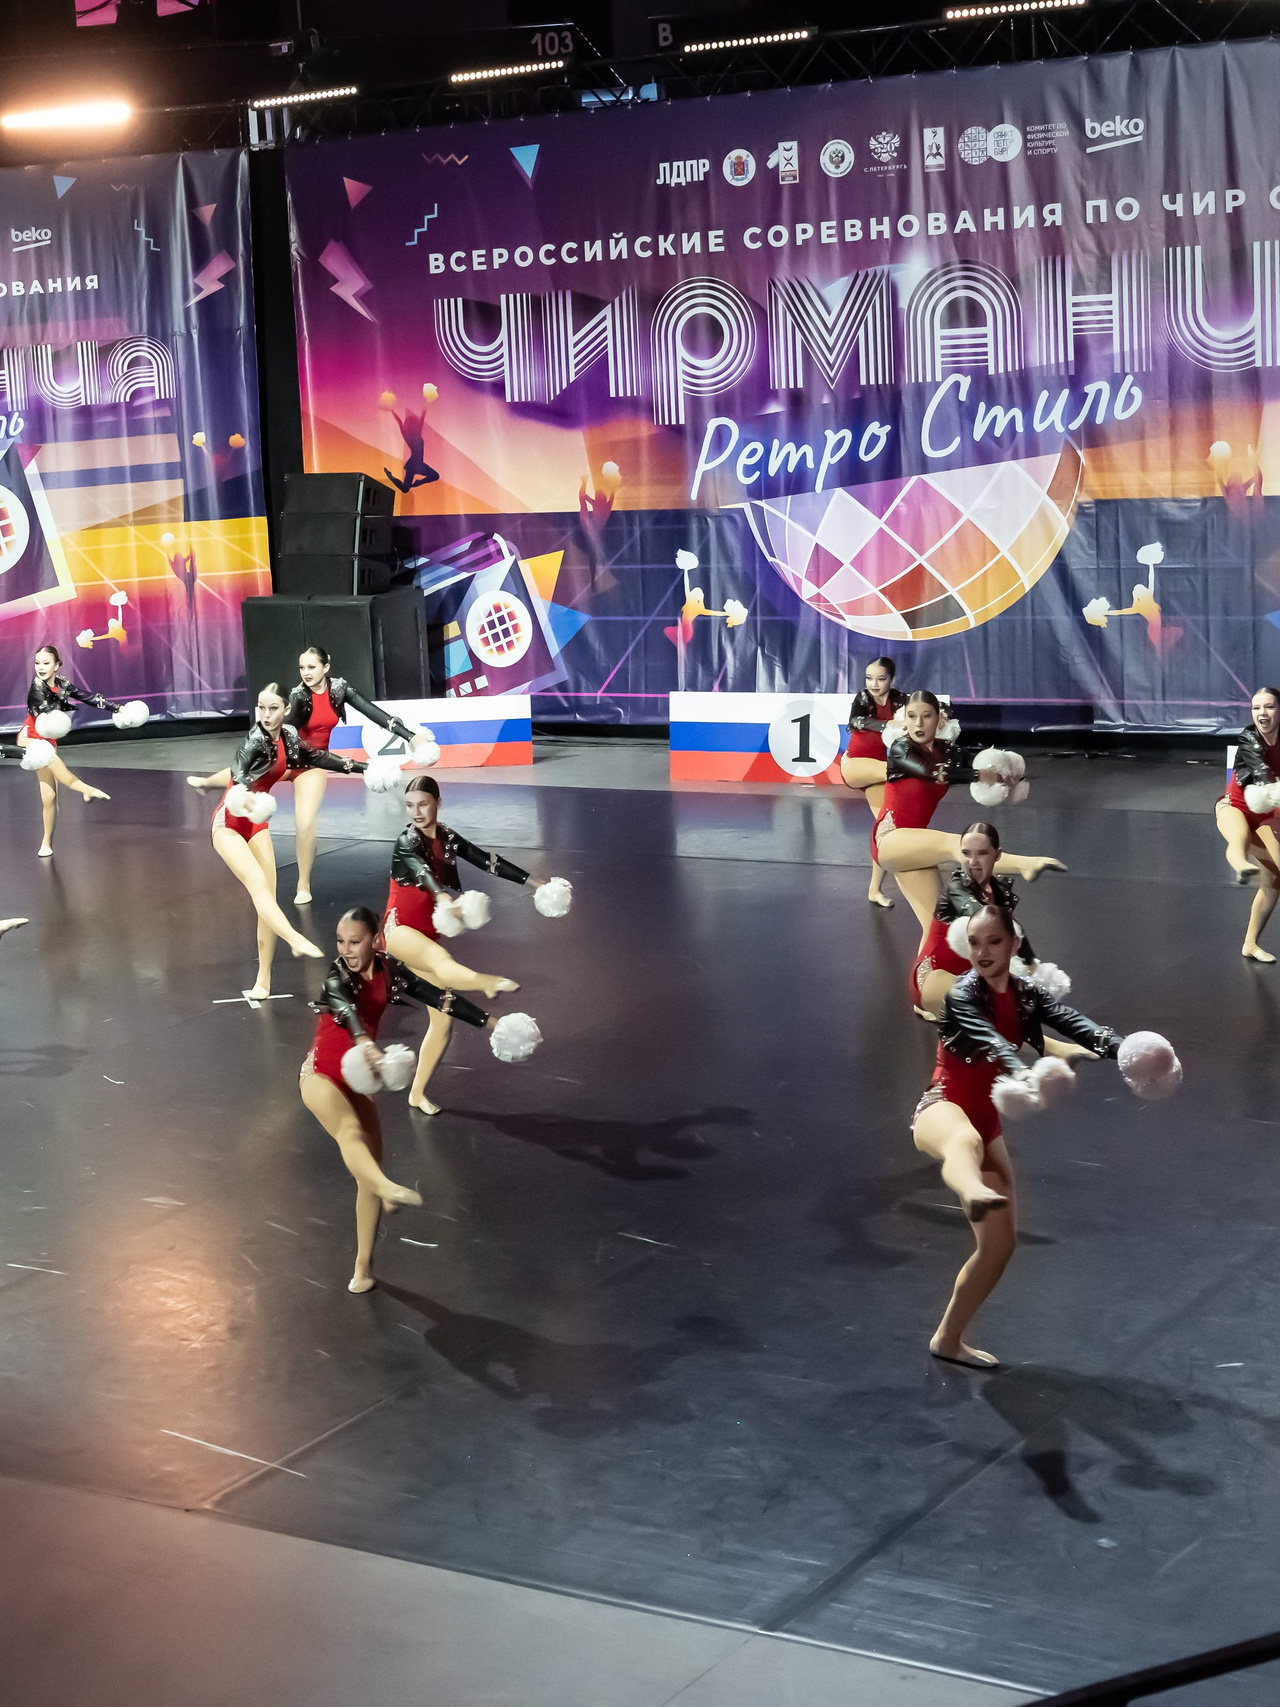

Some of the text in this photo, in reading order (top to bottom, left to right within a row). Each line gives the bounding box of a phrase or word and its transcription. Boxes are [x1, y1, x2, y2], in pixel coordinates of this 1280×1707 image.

[531, 31, 574, 57] 103
[1026, 123, 1055, 132] КОМИТЕТ
[1026, 130, 1070, 140] ФИЗИЧЕСКОЙ
[1085, 115, 1144, 139] beko
[1026, 140, 1056, 148] КУЛЬТУРЕ
[656, 159, 710, 187] ЛДПР
[11, 226, 52, 243] beko
[428, 229, 725, 275] ВСЕРОССИЙСКИЕ
[743, 202, 1063, 250] СОРЕВНОВАНИЯ
[1086, 196, 1140, 223] ПО
[1162, 189, 1246, 217] ЧИР
[690, 373, 1143, 500] Ретро Стиль
[791, 713, 817, 763] 1
